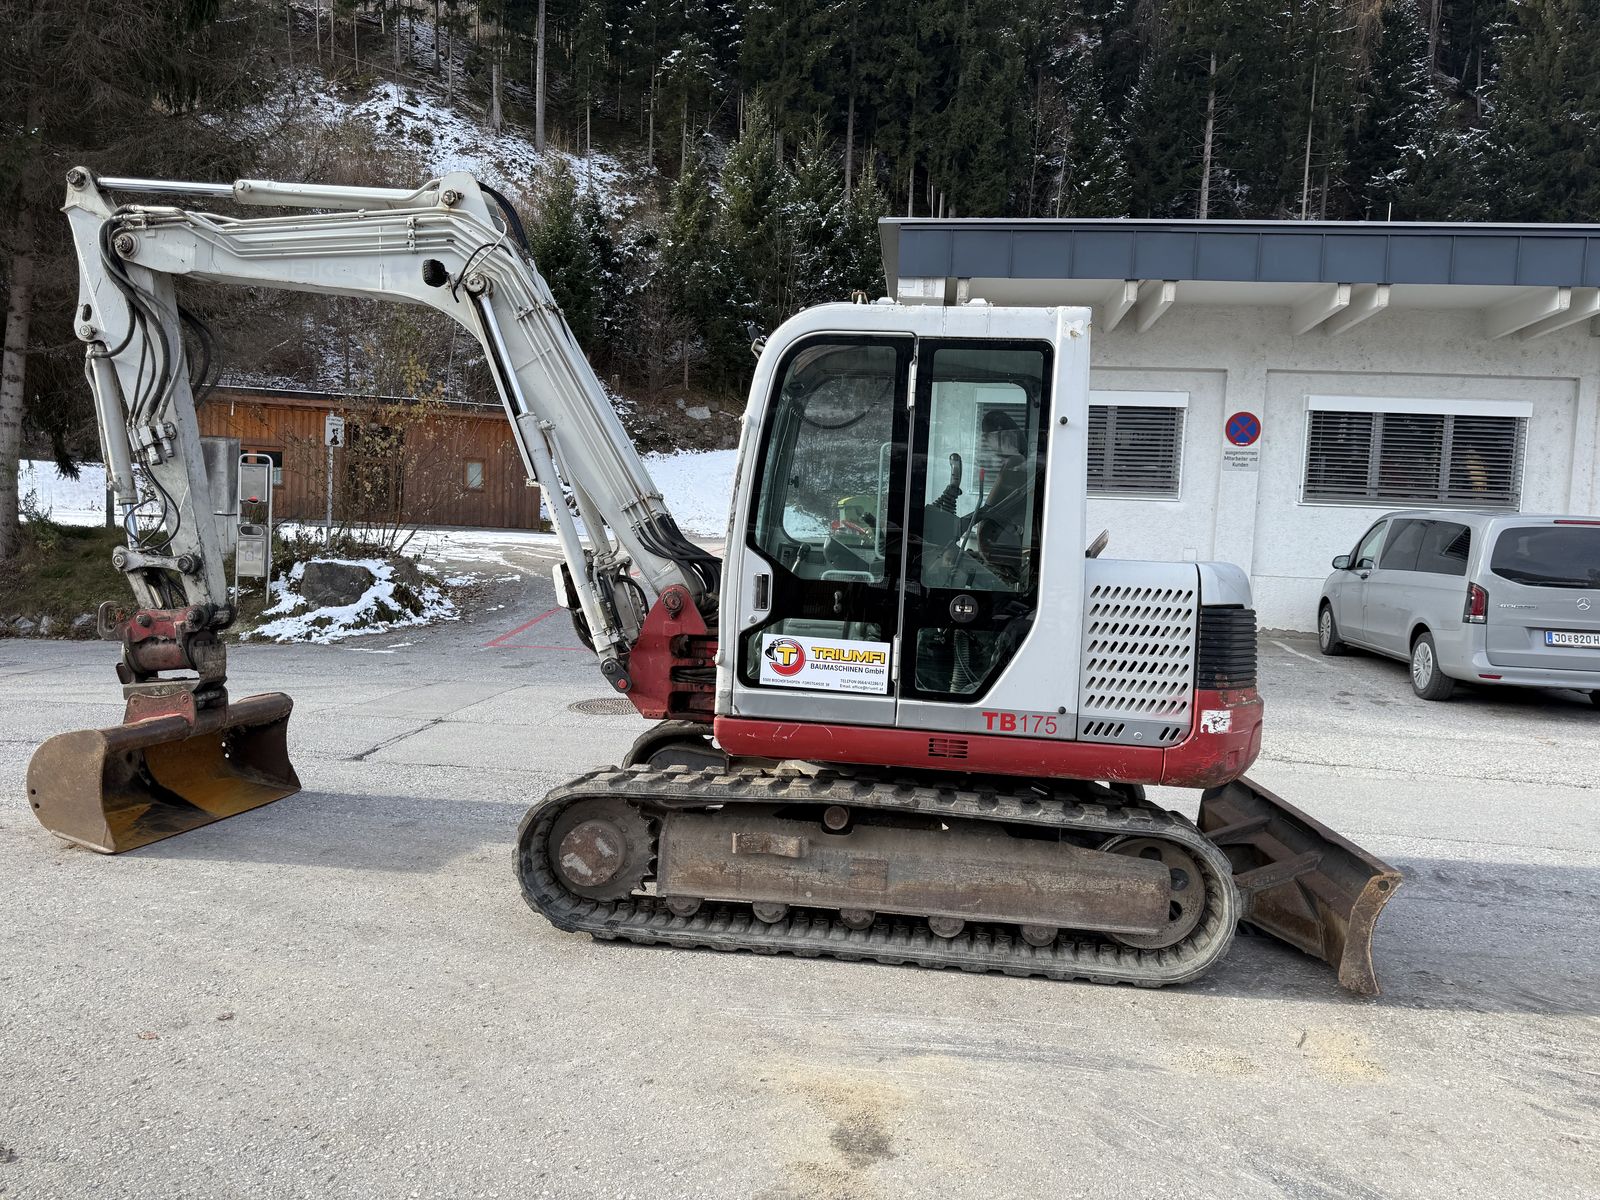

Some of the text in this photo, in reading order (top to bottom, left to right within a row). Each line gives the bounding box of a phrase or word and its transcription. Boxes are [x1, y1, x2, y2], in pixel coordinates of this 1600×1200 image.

[1554, 633, 1567, 643] JO
[1573, 634, 1592, 644] 820
[810, 664, 885, 675] BAUMASCHINEN GmbH
[982, 712, 1057, 735] TB175
